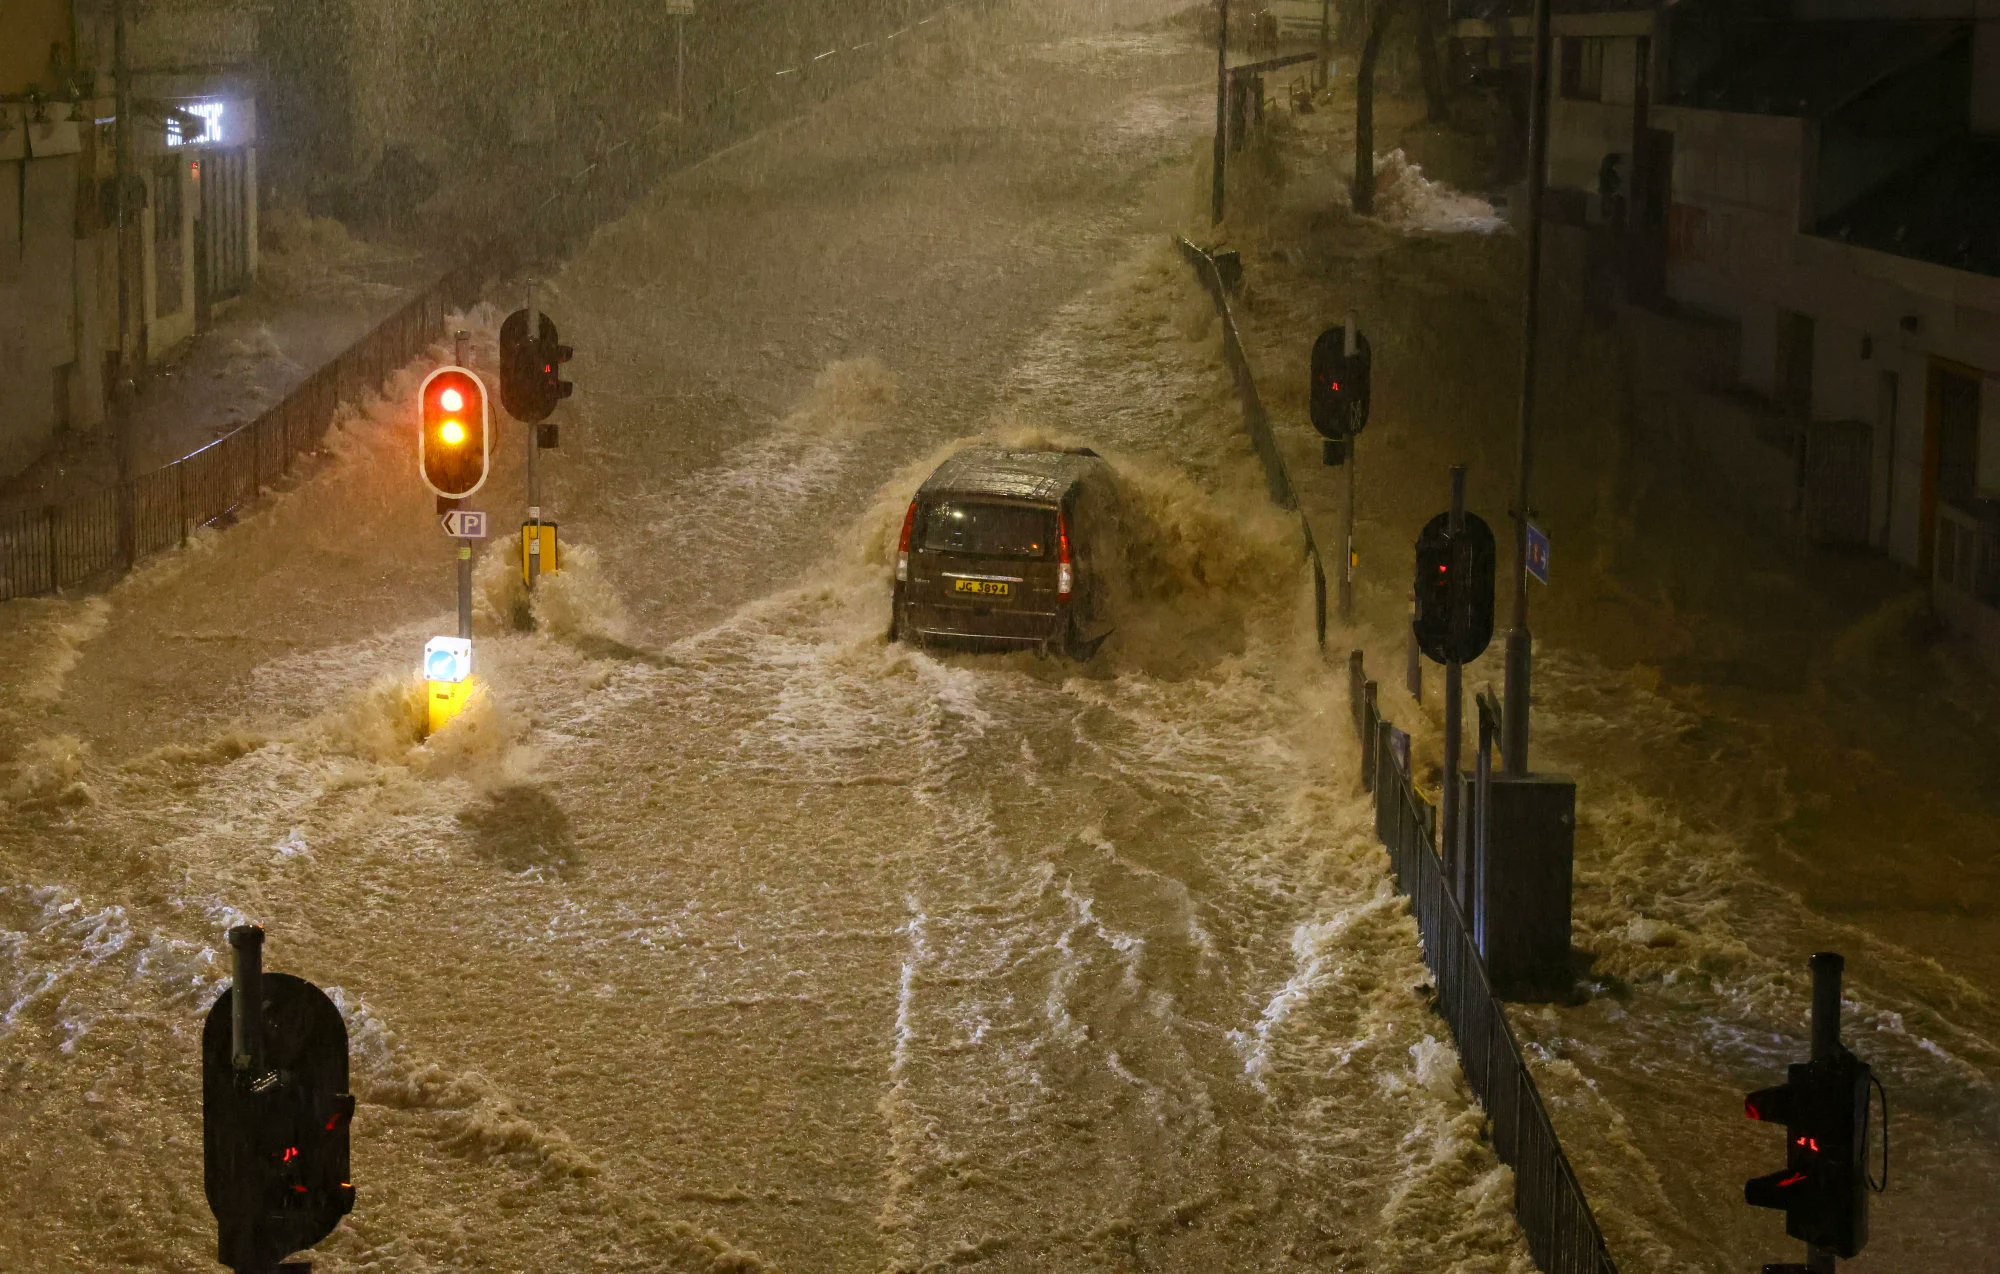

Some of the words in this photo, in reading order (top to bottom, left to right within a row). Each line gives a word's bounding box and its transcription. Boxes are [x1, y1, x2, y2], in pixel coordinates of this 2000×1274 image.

[464, 515, 479, 534] P
[958, 582, 973, 592] JG
[977, 582, 1006, 593] 3894
